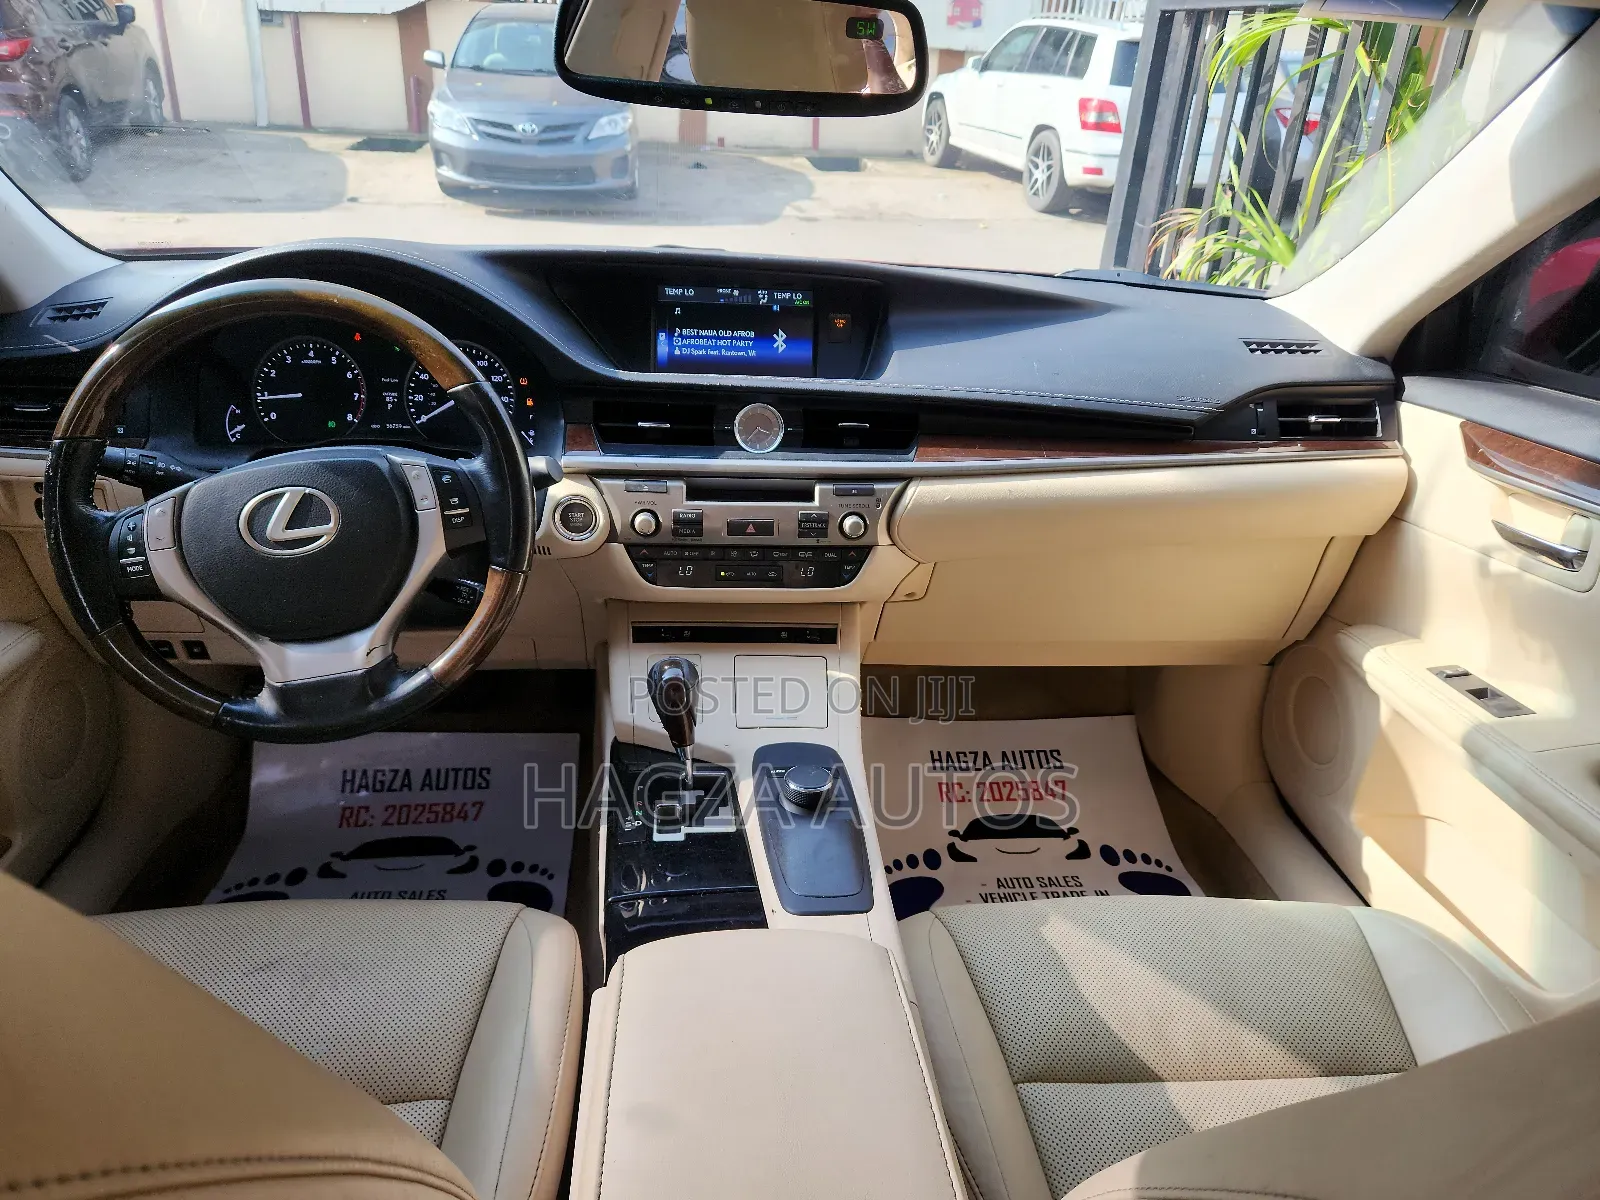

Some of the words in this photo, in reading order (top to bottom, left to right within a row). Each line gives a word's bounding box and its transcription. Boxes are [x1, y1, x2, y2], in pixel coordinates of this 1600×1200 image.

[665, 287, 683, 295] TEMP
[684, 288, 695, 296] LO
[792, 292, 803, 300] LO
[682, 328, 698, 336] BEST
[718, 329, 732, 337] OLD
[733, 330, 755, 338] AFROB
[682, 338, 716, 346] AFROBEAT
[308, 350, 315, 358] 4
[691, 347, 707, 356] Spark
[285, 355, 292, 364] 3
[331, 356, 337, 365] 5
[270, 369, 276, 377] 2
[346, 371, 353, 379] 6
[353, 392, 360, 401] 7
[413, 394, 424, 402] 20
[269, 411, 277, 420] 0
[346, 413, 353, 421] 8
[451, 516, 465, 524] DISP
[126, 564, 144, 573] MODE
[929, 750, 995, 771] HAGZA
[1001, 749, 1065, 770] AUTOS
[341, 766, 413, 793] HAGZA
[420, 766, 491, 791] AUTOS
[938, 781, 972, 803] RC:
[976, 780, 1067, 802] 2025847
[338, 805, 375, 829] RC:
[381, 801, 485, 826] 2025847
[996, 877, 1034, 889] AUTO
[1036, 875, 1084, 888] SALES
[397, 889, 447, 900] SALES
